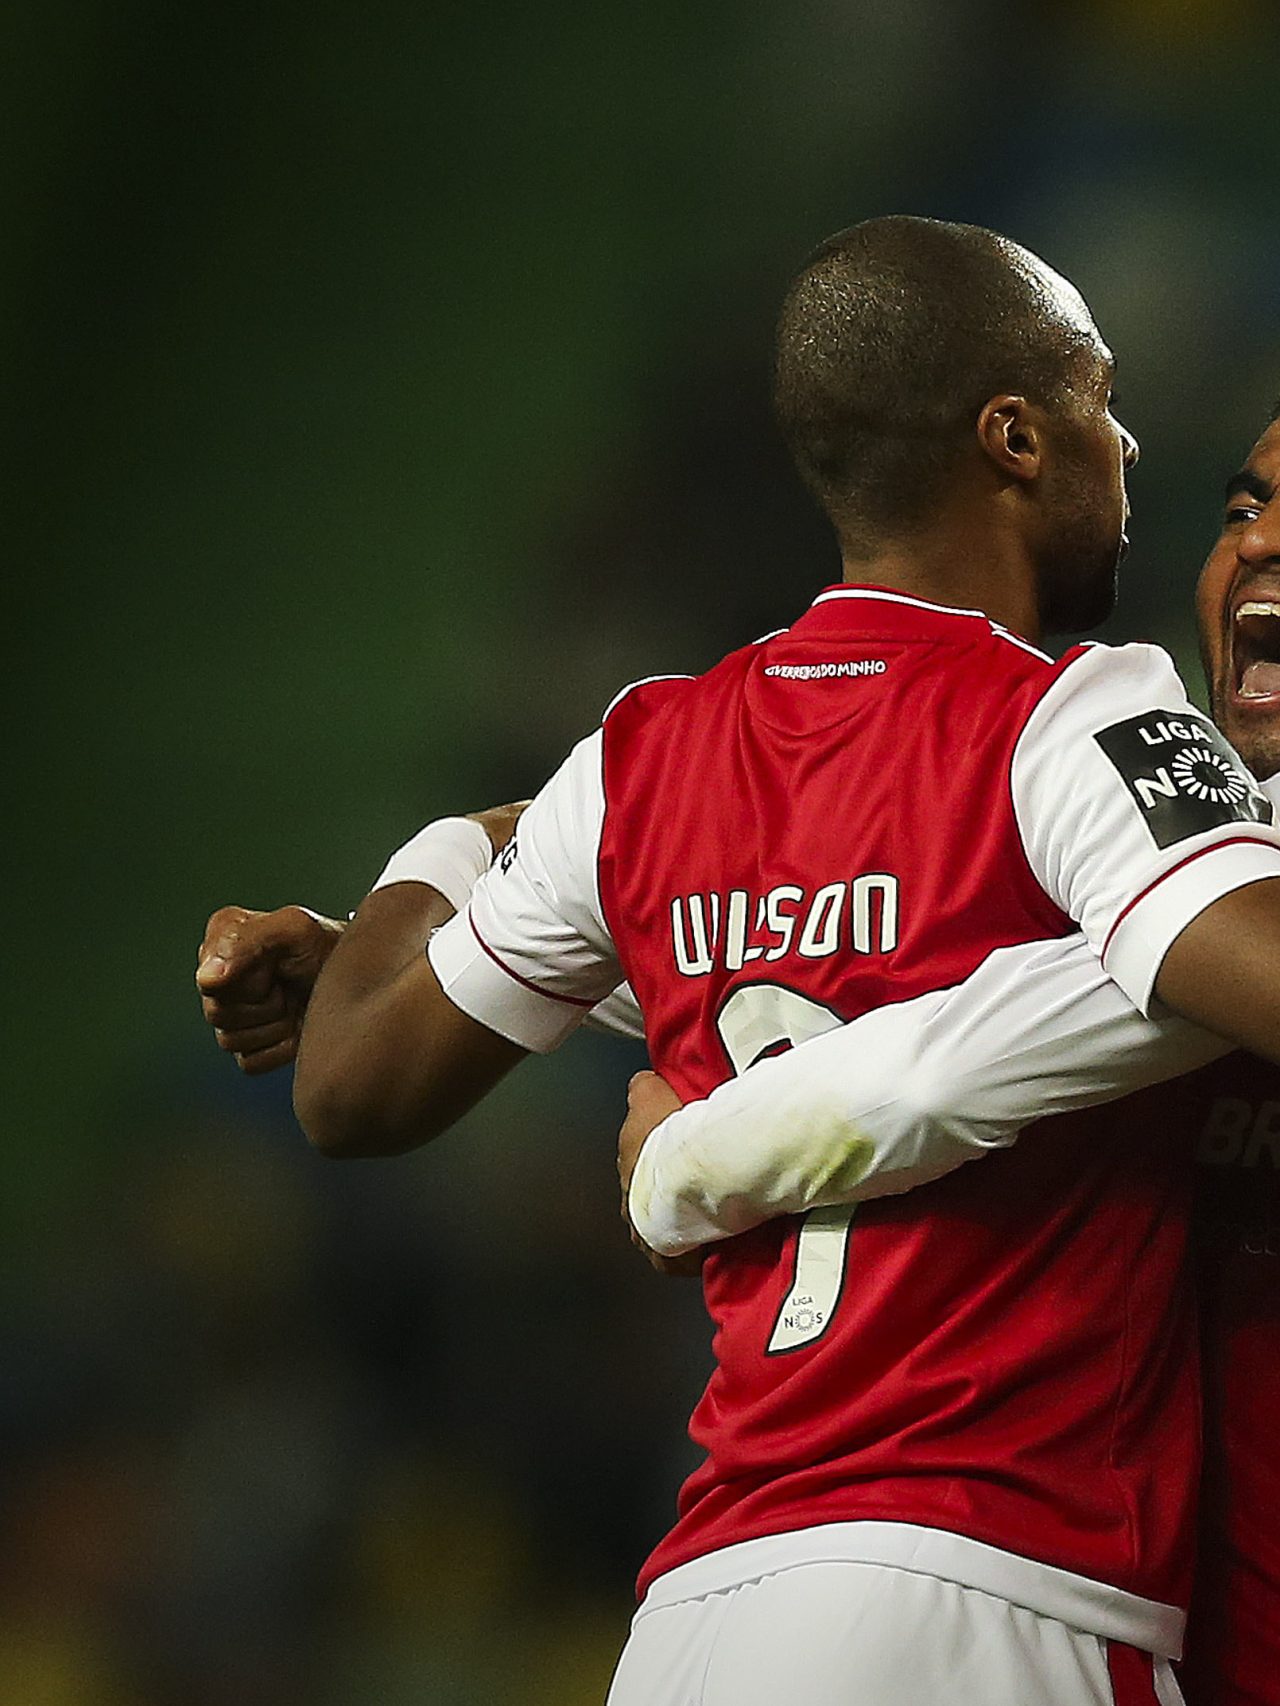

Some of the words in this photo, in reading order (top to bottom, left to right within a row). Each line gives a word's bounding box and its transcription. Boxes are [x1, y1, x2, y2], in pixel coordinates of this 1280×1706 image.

[837, 660, 886, 677] MINHO
[1138, 711, 1213, 746] LIGA
[671, 874, 898, 976] WILSON
[792, 1296, 814, 1306] LIGA
